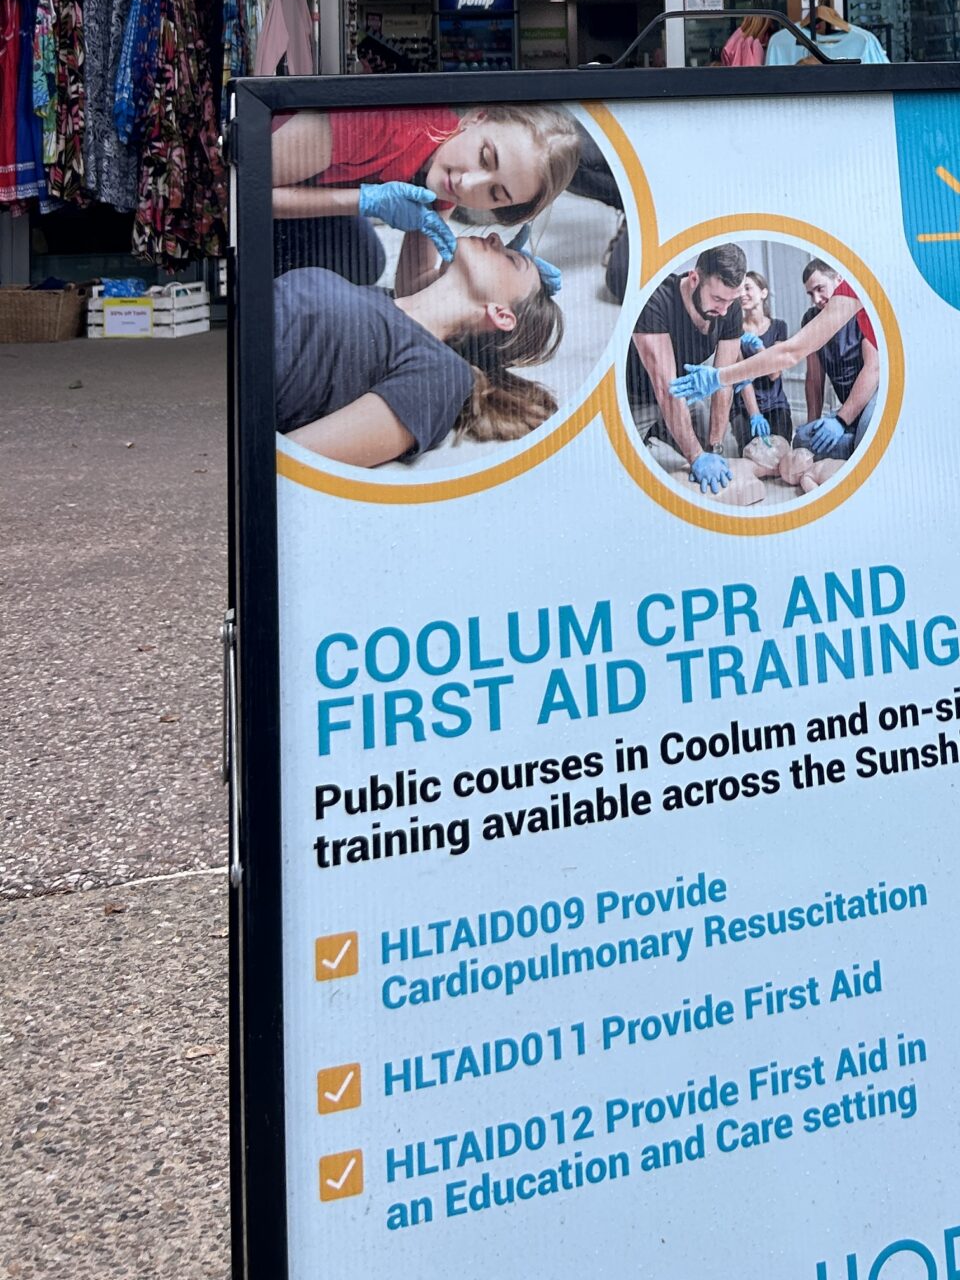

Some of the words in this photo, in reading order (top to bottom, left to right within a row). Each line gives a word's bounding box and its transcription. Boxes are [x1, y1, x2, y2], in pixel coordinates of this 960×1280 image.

[315, 600, 612, 689] COOLUM
[636, 582, 761, 648] CPR
[783, 564, 907, 629] AND
[317, 675, 514, 756] FIRST
[537, 658, 647, 725] AID
[667, 614, 960, 704] TRAINING
[313, 816, 470, 869] training
[482, 782, 652, 841] available
[662, 768, 781, 811] across
[790, 754, 846, 791] the
[315, 767, 441, 820] Public
[453, 751, 604, 797] courses
[615, 738, 648, 773] in
[660, 720, 796, 765] Coolum
[806, 701, 869, 743] and
[381, 896, 585, 965] HLTAID009
[597, 871, 727, 925] Provide
[382, 926, 694, 1010] Cardiopulmonary
[704, 881, 928, 948] Resuscitation
[384, 1021, 586, 1097] HLTAID011
[602, 993, 735, 1051] Provide
[744, 977, 821, 1020] First
[829, 959, 883, 1003] Aid
[386, 1104, 595, 1184] HLTAID012
[606, 1074, 740, 1134] Provide
[749, 1056, 826, 1101] First
[835, 1036, 888, 1082] Aid
[897, 1033, 928, 1067] in
[386, 1192, 433, 1231] an
[446, 1150, 630, 1218] Education
[640, 1123, 706, 1173] and
[716, 1113, 794, 1154] Care
[803, 1083, 918, 1133] setting
